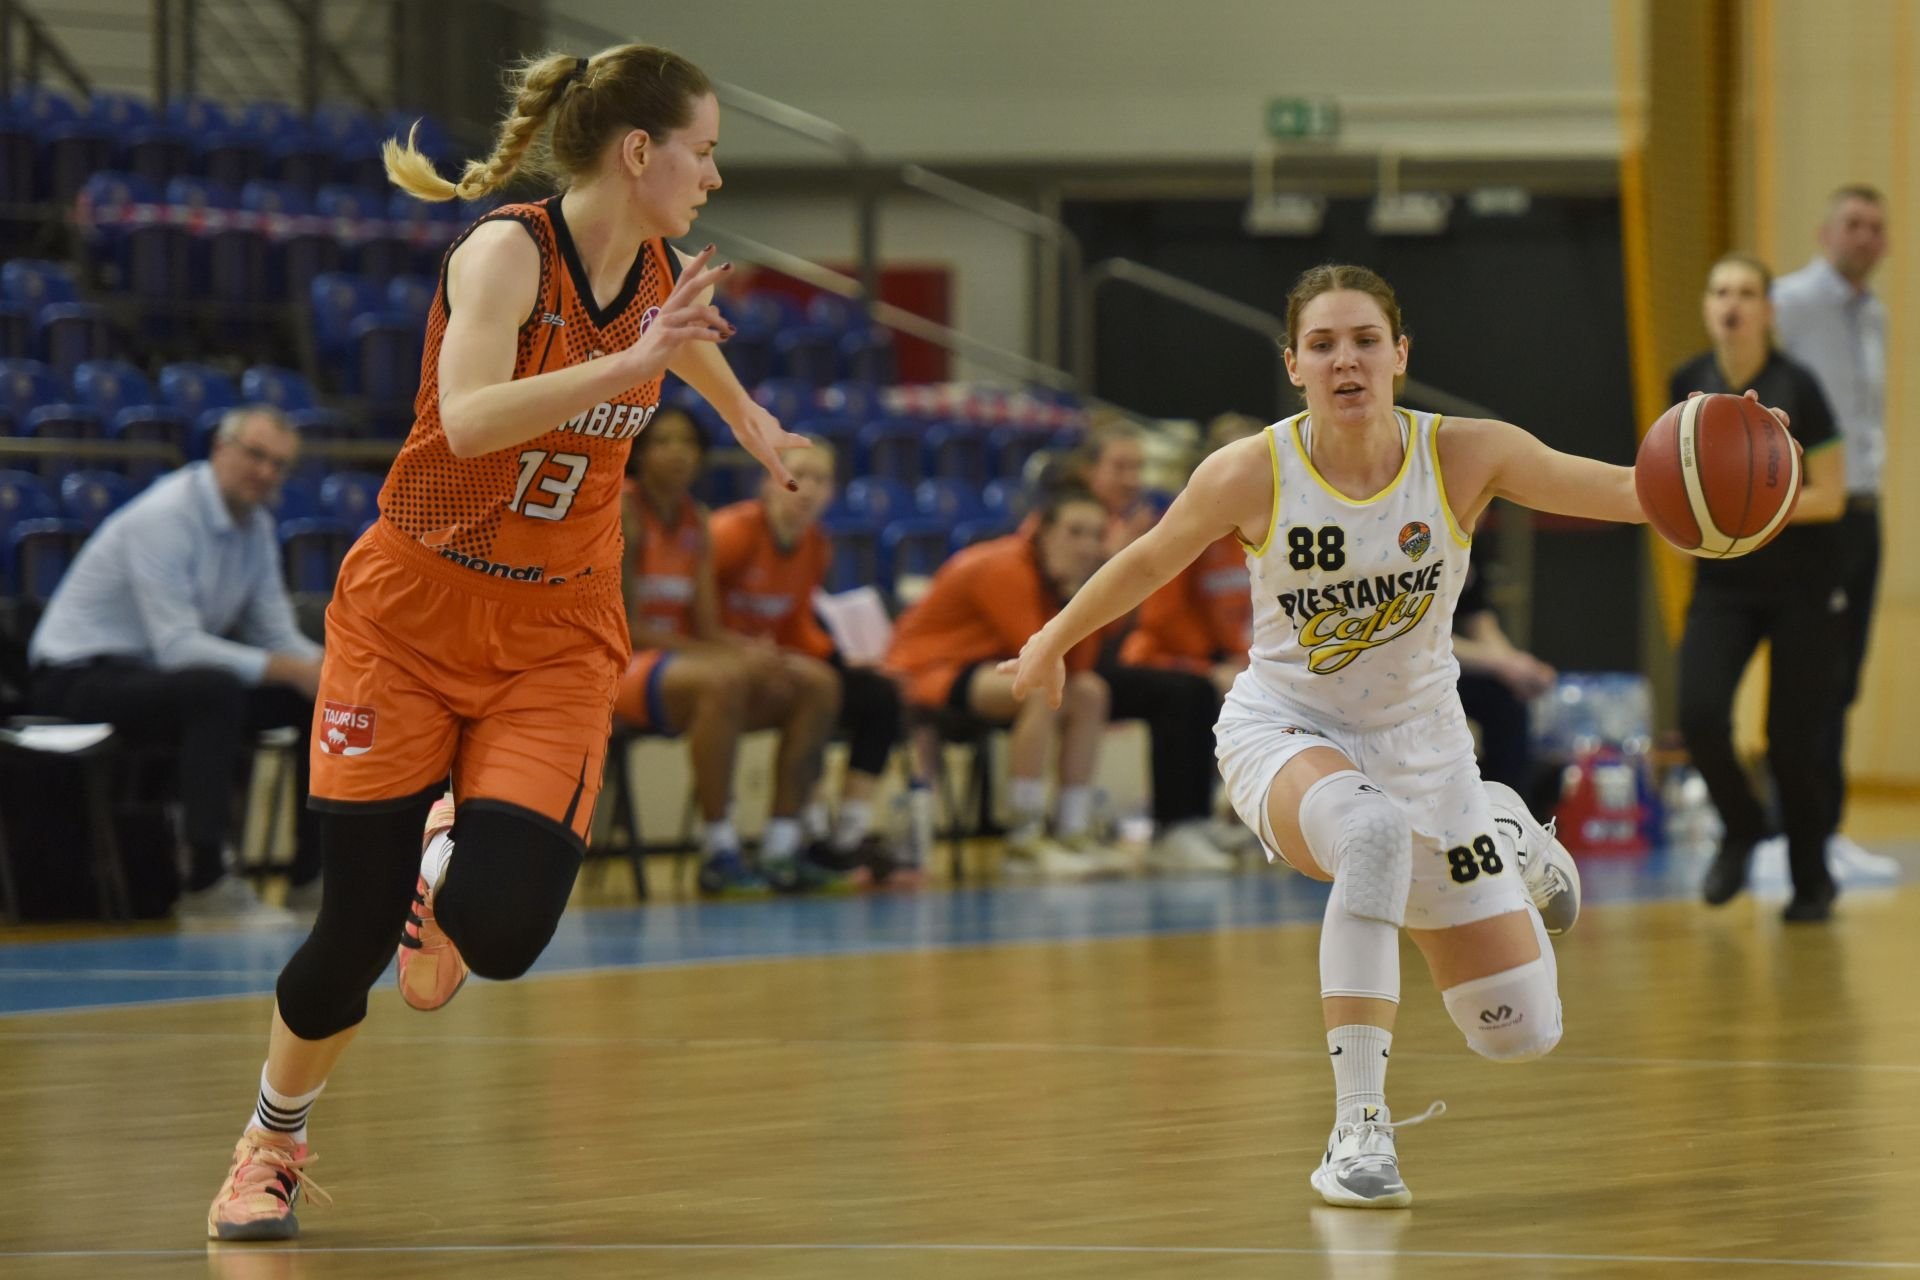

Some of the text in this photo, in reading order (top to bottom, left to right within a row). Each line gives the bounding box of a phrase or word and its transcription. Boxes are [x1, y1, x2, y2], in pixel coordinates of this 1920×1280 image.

[508, 449, 591, 521] 13
[440, 549, 544, 583] mondi
[1288, 526, 1346, 572] 88
[324, 708, 369, 729] TAURIS
[1447, 833, 1504, 884] 88
